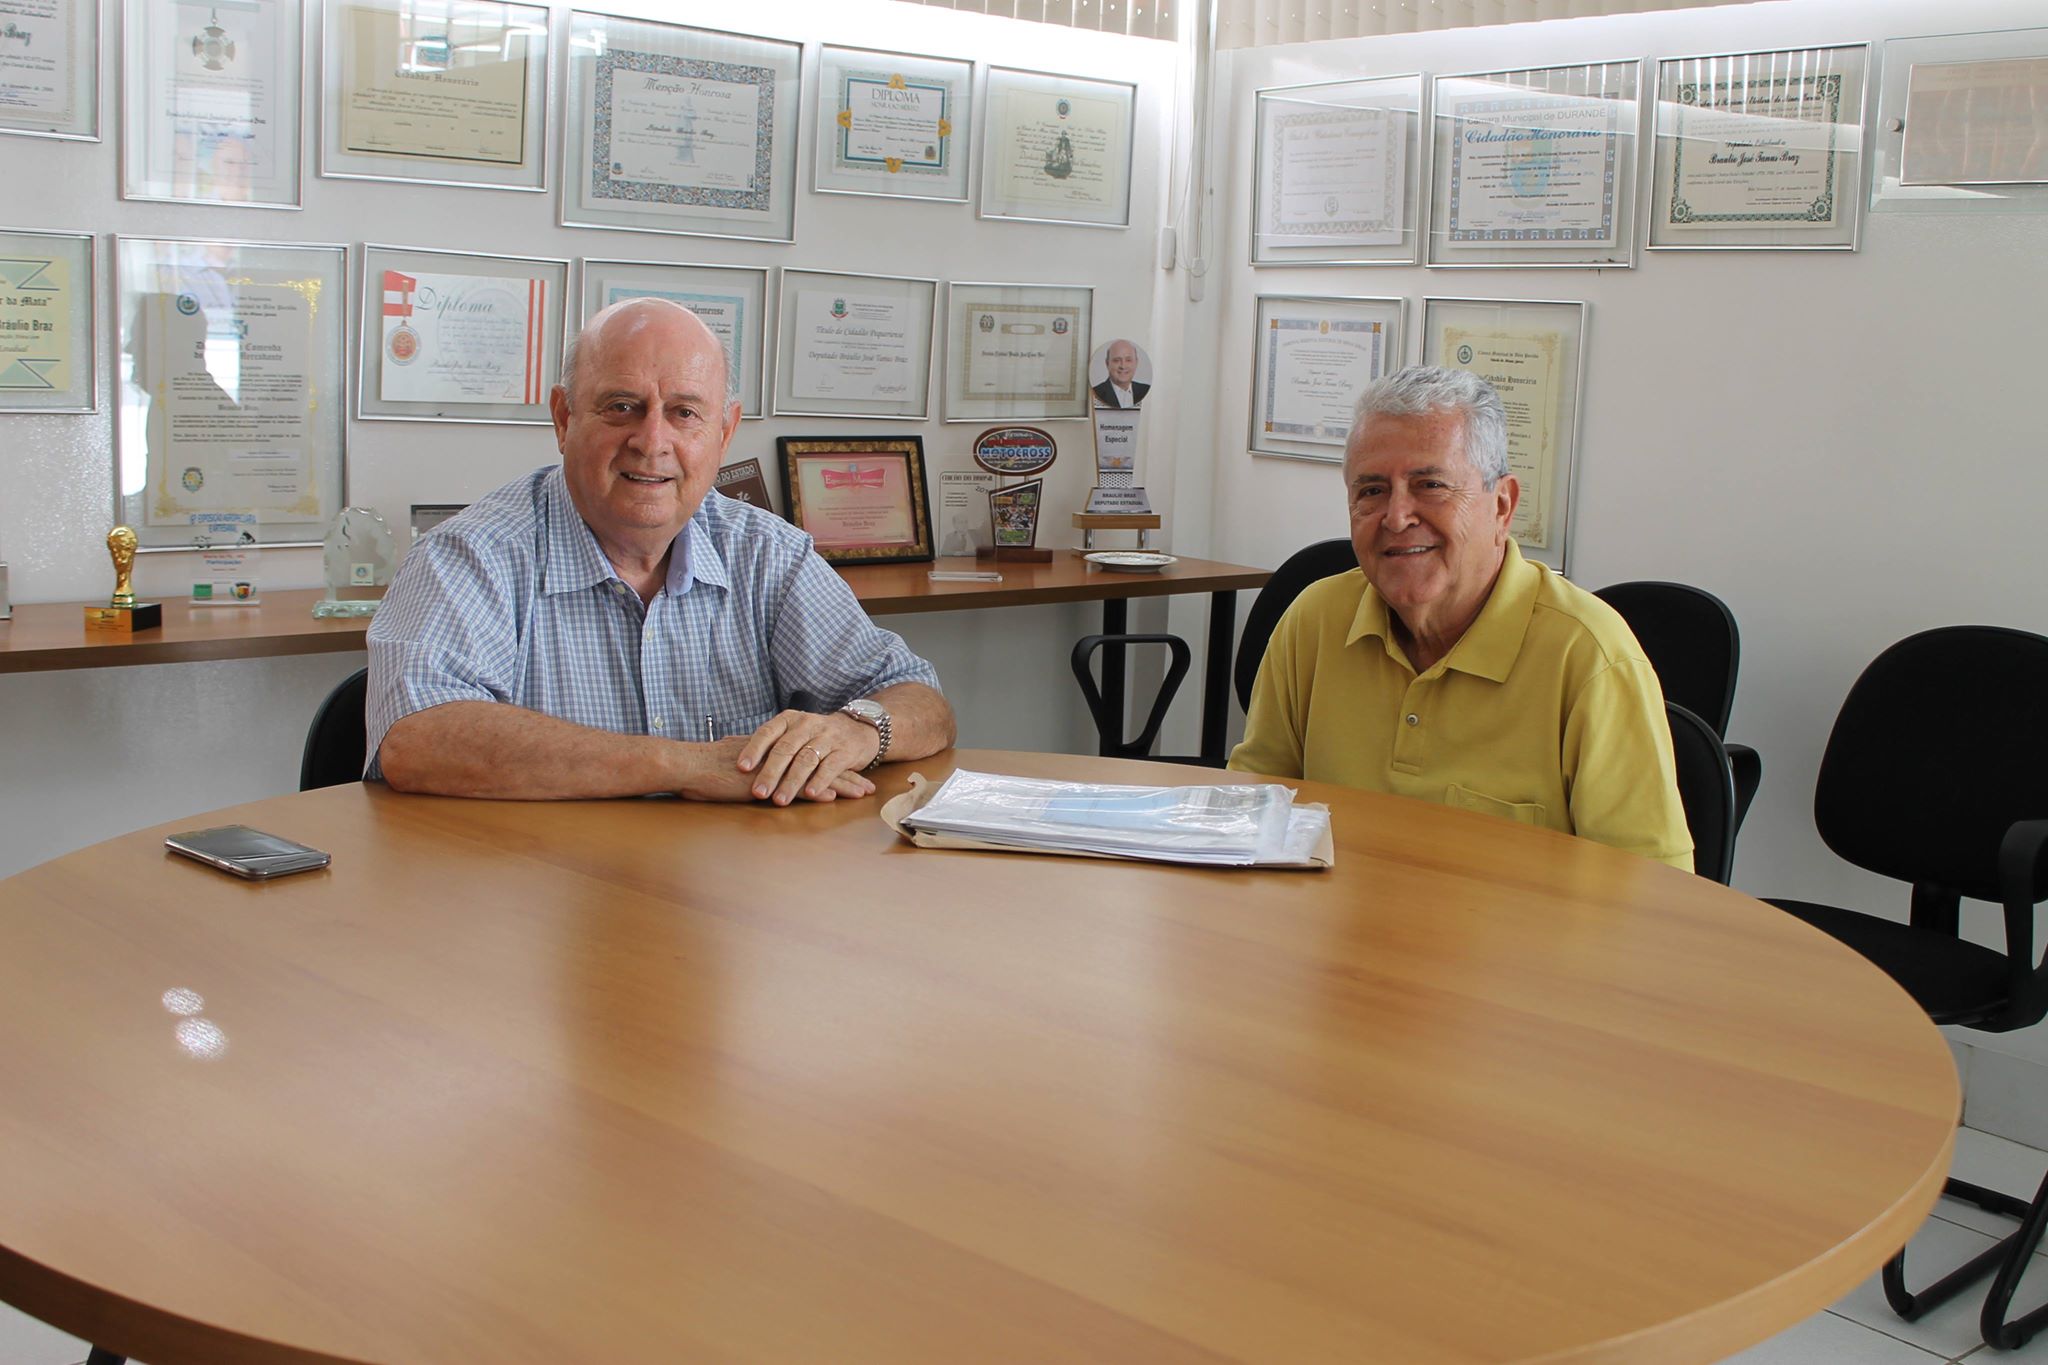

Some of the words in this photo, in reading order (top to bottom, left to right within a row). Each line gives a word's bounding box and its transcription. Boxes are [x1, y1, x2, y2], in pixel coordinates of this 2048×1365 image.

[642, 77, 686, 95] Menção
[688, 82, 733, 99] Honrosa
[872, 88, 921, 104] DIPLOMA
[1502, 113, 1543, 124] Municipal
[1543, 113, 1555, 121] de
[1465, 128, 1524, 144] Cidadão
[1526, 126, 1602, 141] Honorário
[1779, 151, 1801, 166] Braz
[416, 286, 494, 319] Diploma
[32, 319, 53, 332] Braz
[1100, 424, 1134, 432] Homenagem
[1104, 435, 1128, 443] Especial
[981, 447, 1051, 458] MOTOCROSS
